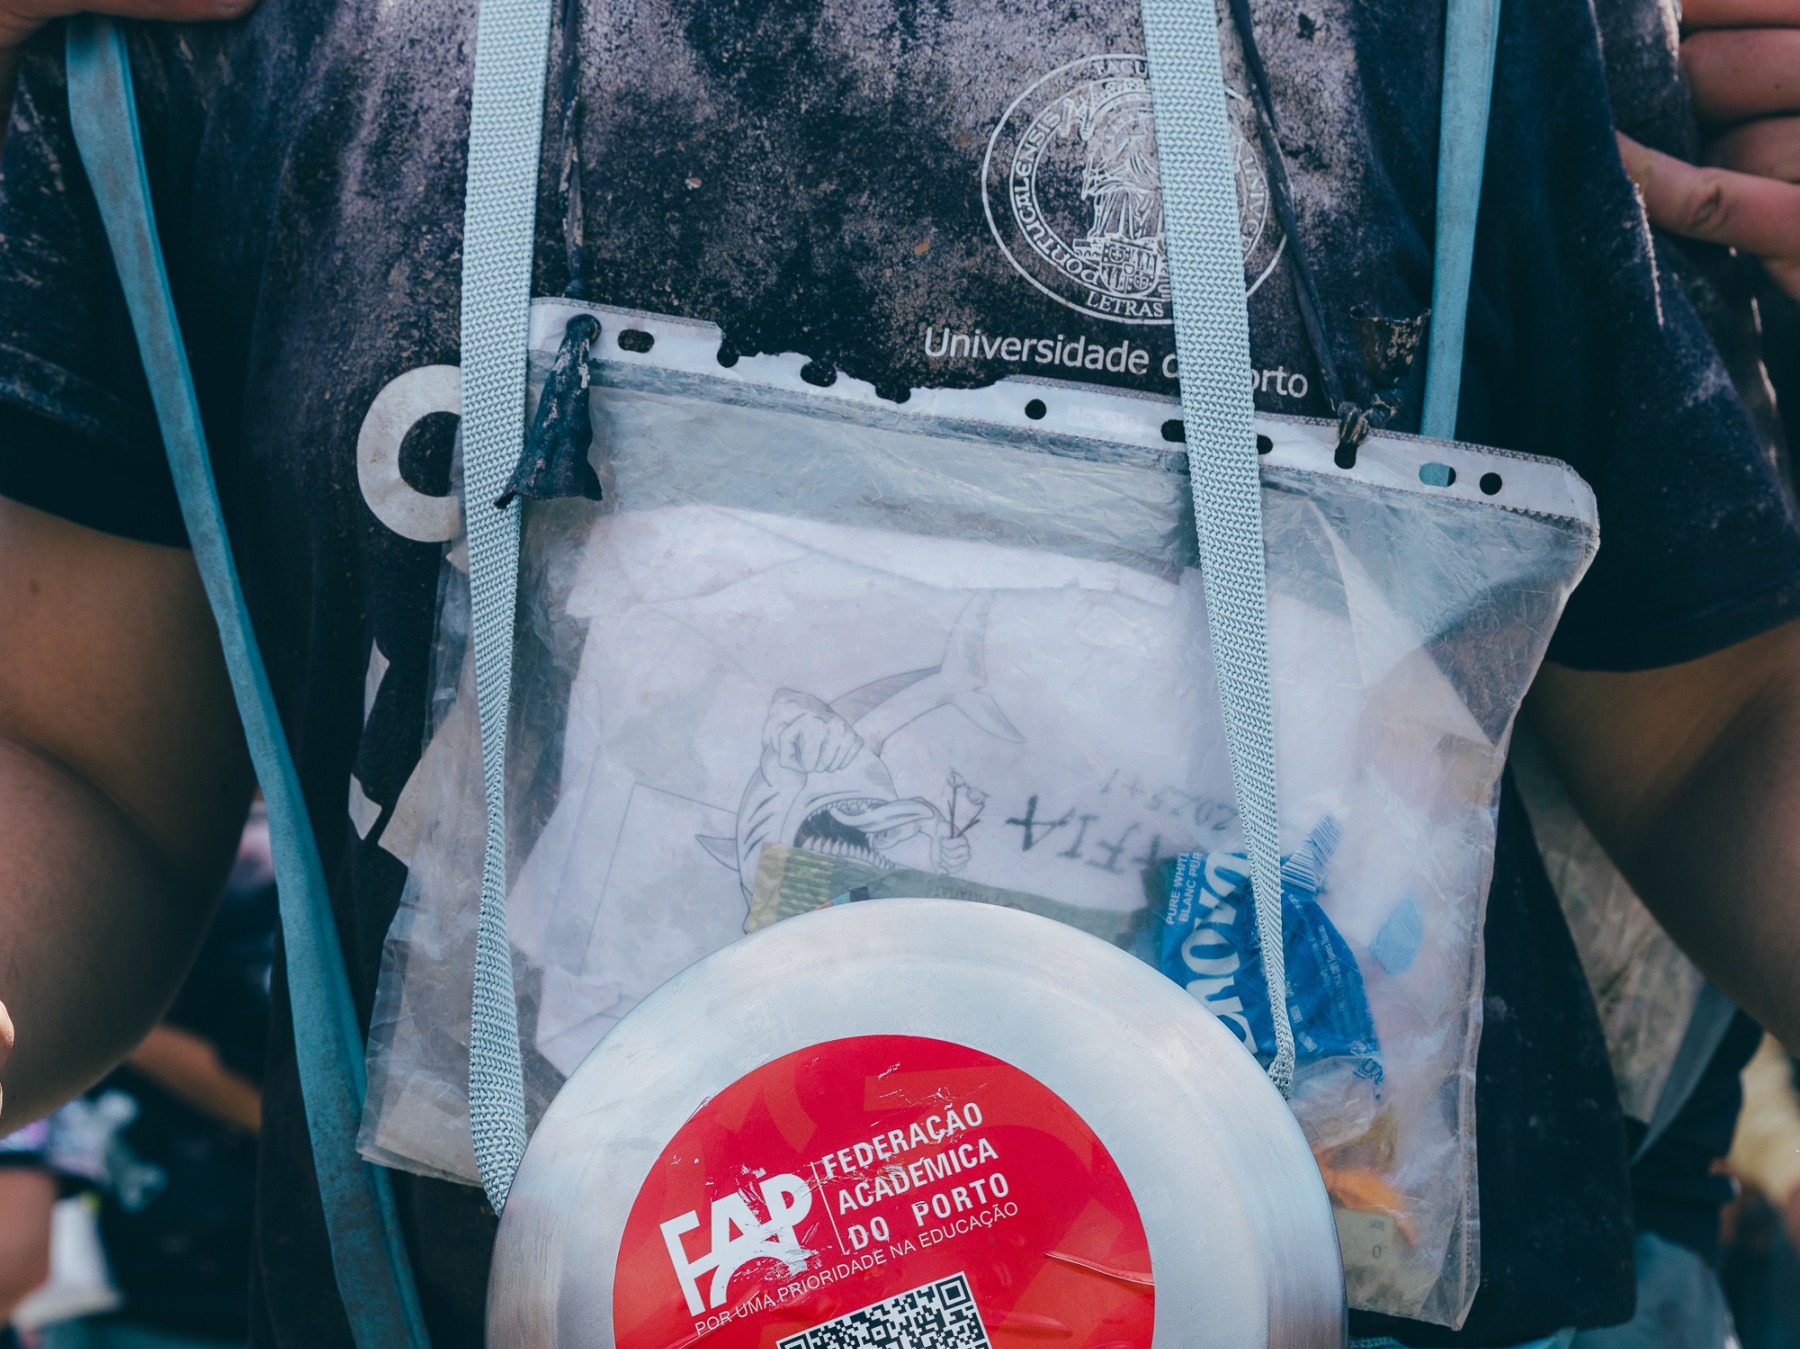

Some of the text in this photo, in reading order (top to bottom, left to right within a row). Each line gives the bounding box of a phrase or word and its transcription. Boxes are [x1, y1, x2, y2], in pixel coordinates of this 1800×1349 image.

[1086, 291, 1164, 317] LETRAS
[924, 326, 1150, 374] Universidade
[1166, 897, 1182, 925] PURE
[1178, 879, 1196, 923] BLANC
[821, 1102, 984, 1179] FEDERAÇÃO
[838, 1137, 999, 1215] ACADÉMICA
[660, 1173, 813, 1317] FAP
[848, 1172, 1009, 1251] DO PORTO
[694, 1201, 1019, 1336] POR UMA PRIORIDADE NA EDUCAÇÃO
